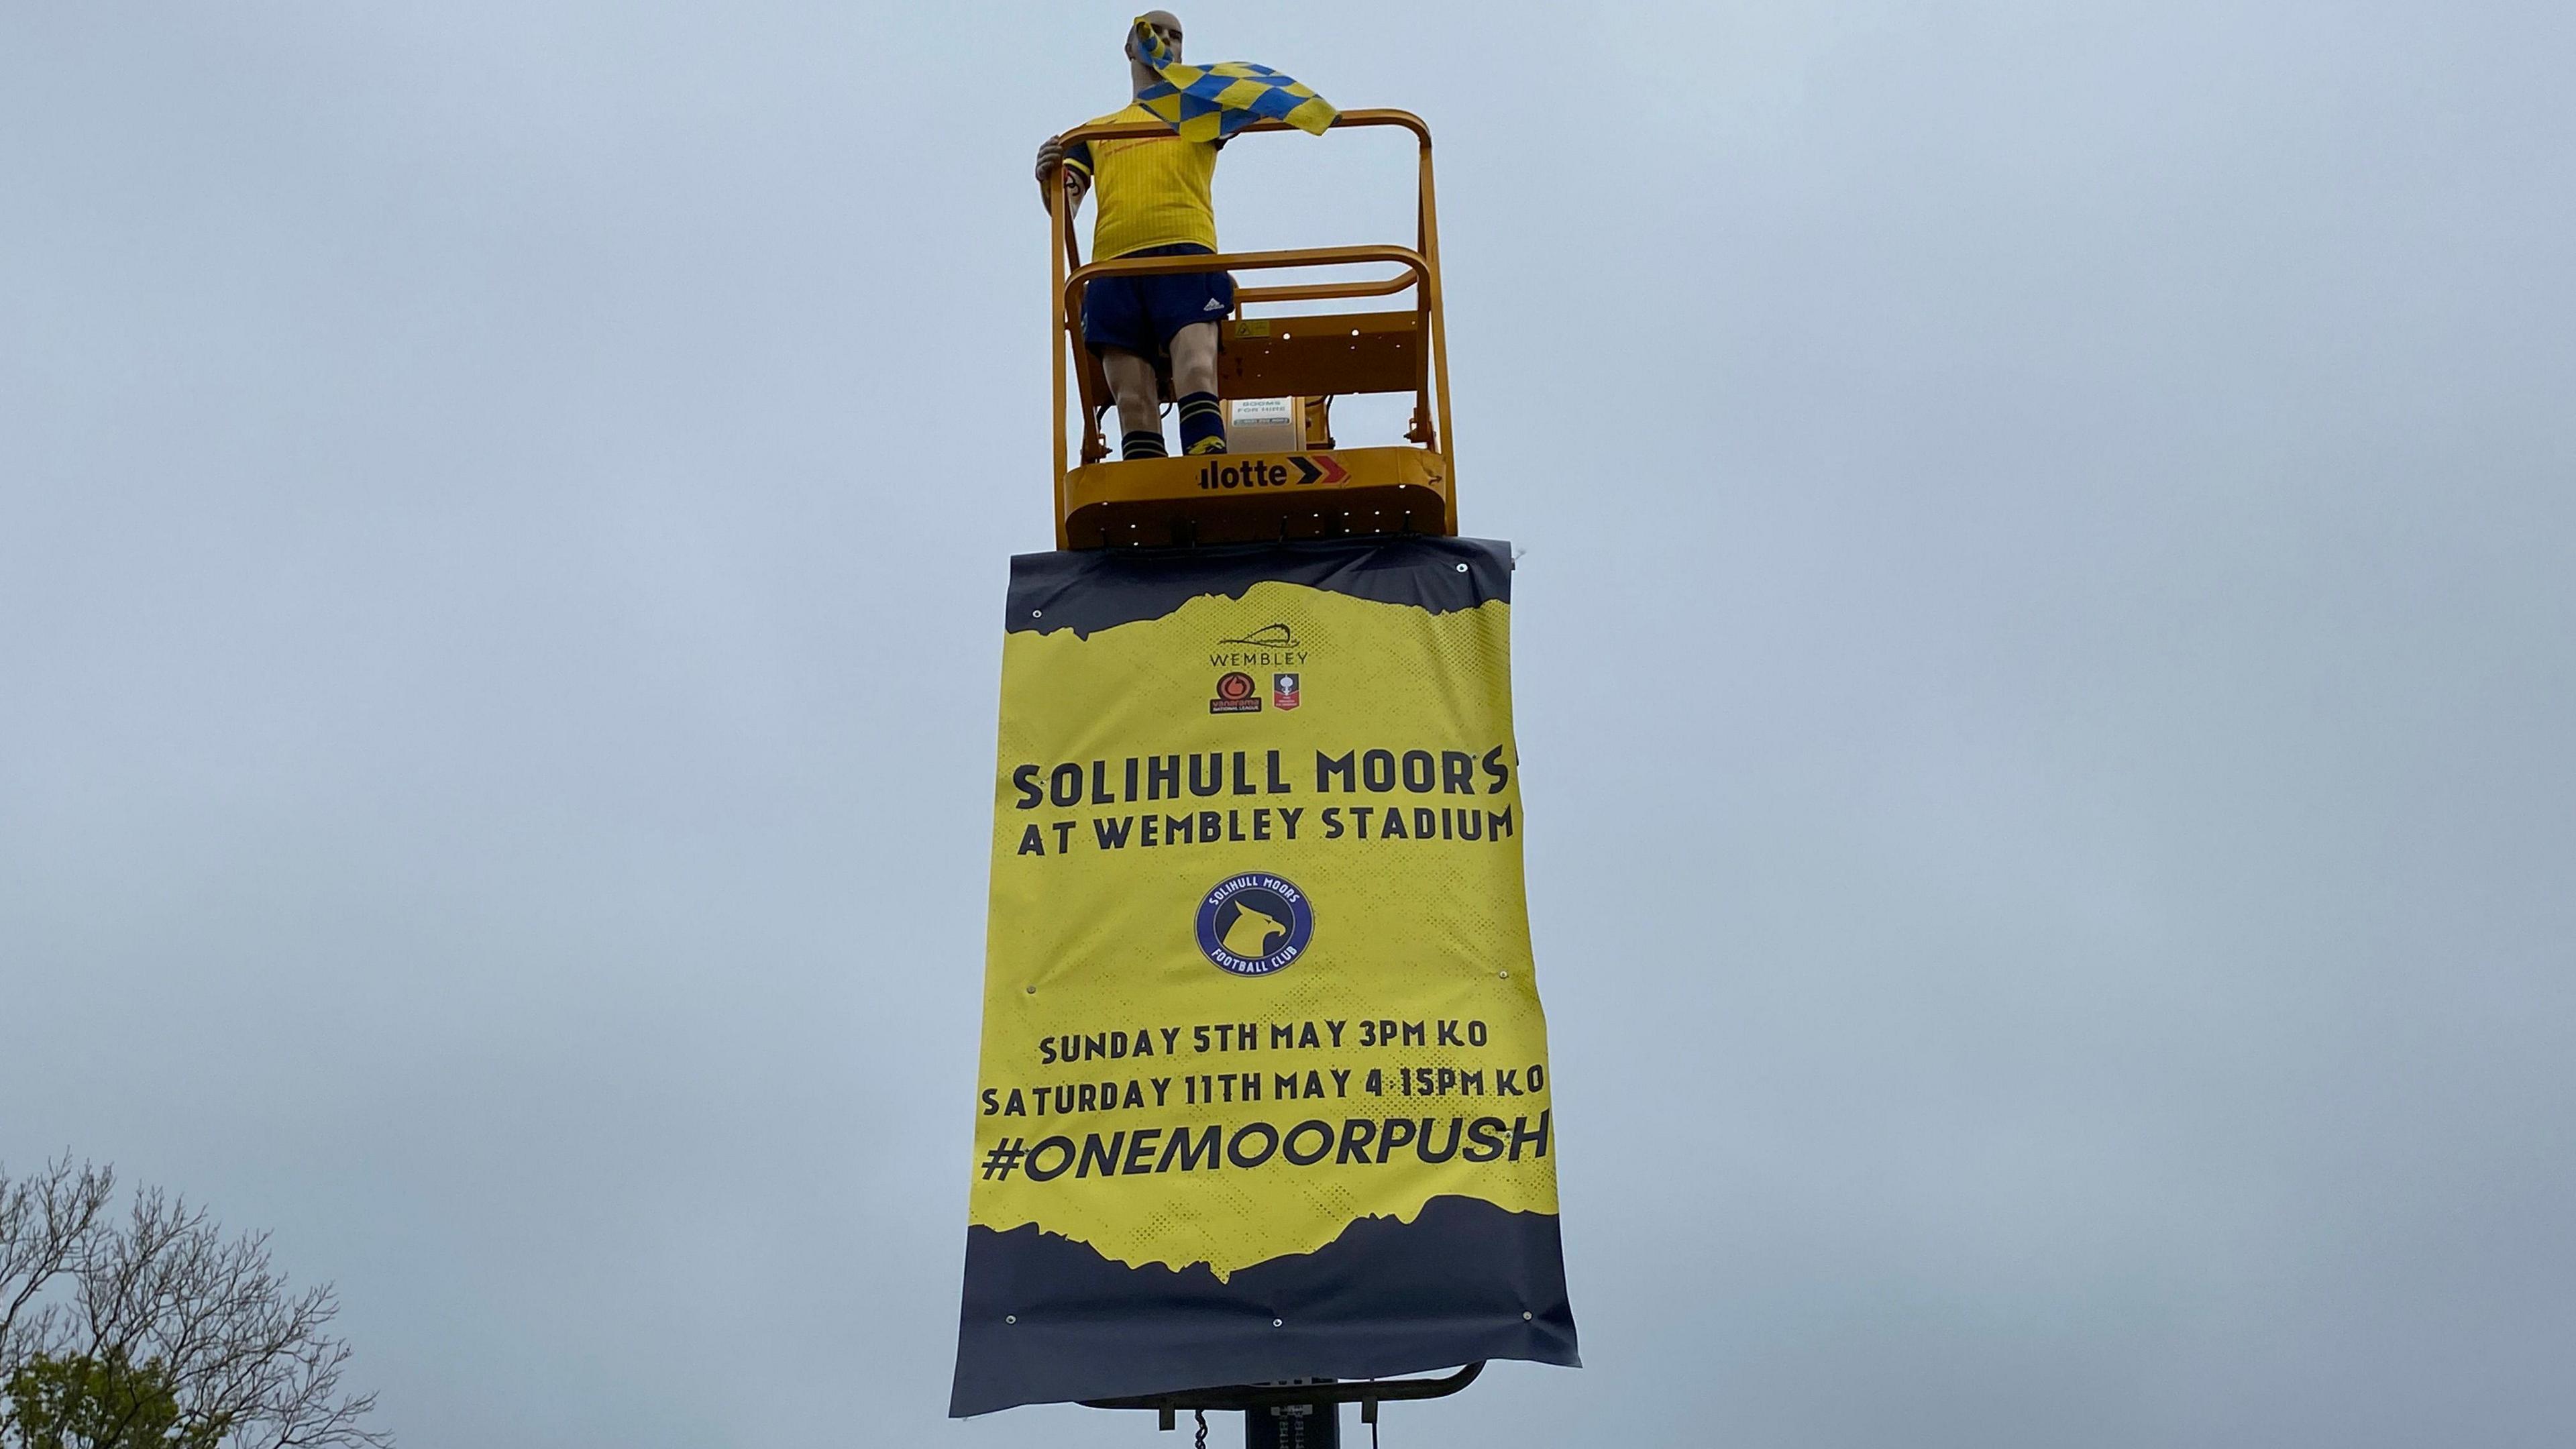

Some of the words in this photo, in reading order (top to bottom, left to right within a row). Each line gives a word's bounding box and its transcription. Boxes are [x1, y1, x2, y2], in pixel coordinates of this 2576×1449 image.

[1210, 651, 1307, 667] WEMBLEY
[1013, 749, 1291, 810] SOLIHULL
[1316, 744, 1509, 795] MOORS
[1017, 820, 1077, 856] AT
[1093, 807, 1304, 850] WEMBLEY
[1321, 804, 1513, 843] STADIUM
[1209, 875, 1258, 906] SOLIHULL
[1263, 877, 1300, 903] MOORS
[1211, 948, 1269, 973] FOOTBALL
[1271, 946, 1298, 967] CLUB
[1039, 1027, 1181, 1065] SUNDAY
[1193, 1023, 1257, 1053] 5TH
[1271, 1019, 1346, 1050] MAY
[1359, 1020, 1426, 1046] 3PM
[981, 1077, 1172, 1116] SATURDAY
[1185, 1072, 1261, 1104] 11TH
[1275, 1069, 1351, 1100] MAY
[981, 1108, 1550, 1182] #ONEMOORPUSH
